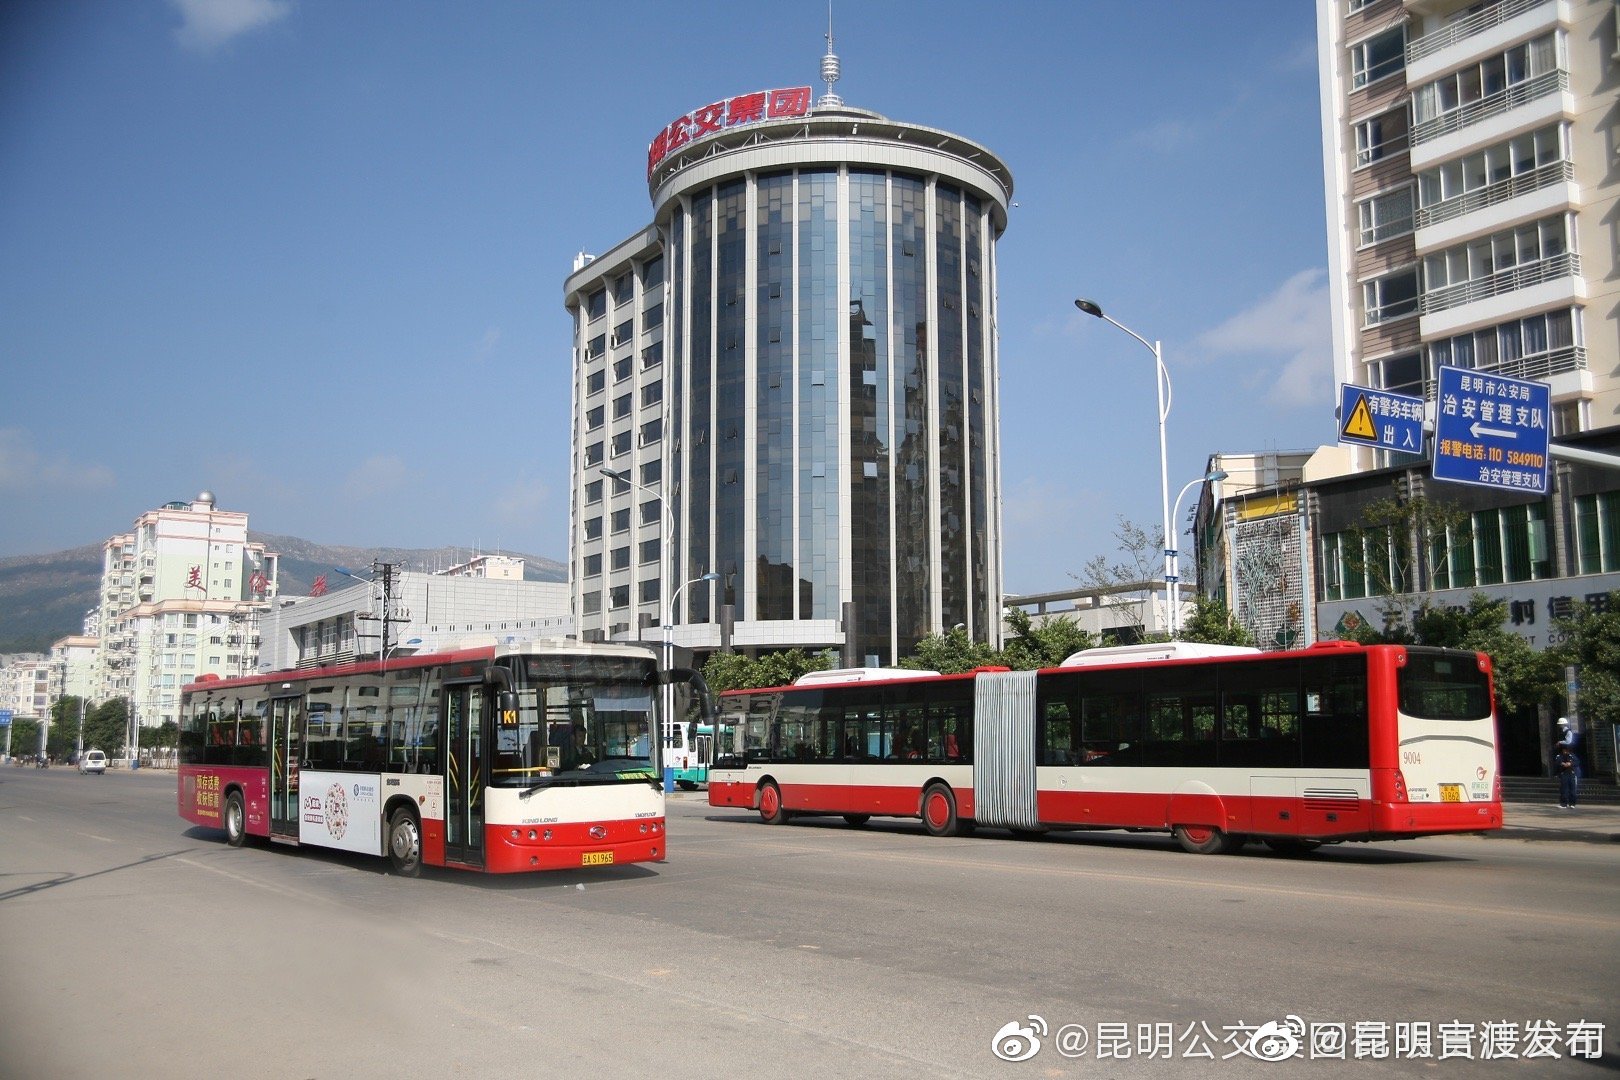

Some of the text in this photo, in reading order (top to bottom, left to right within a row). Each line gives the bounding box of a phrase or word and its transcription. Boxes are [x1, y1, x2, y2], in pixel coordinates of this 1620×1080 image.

[1460, 375, 1531, 402] 昆明市公安局
[1368, 394, 1423, 422] 有警务车辆
[1443, 393, 1545, 430] 治安管理支队
[1507, 452, 1544, 468] 5849110
[1479, 466, 1542, 489] 治安管理支队
[503, 710, 517, 724] K1
[1403, 751, 1421, 765] 9004
